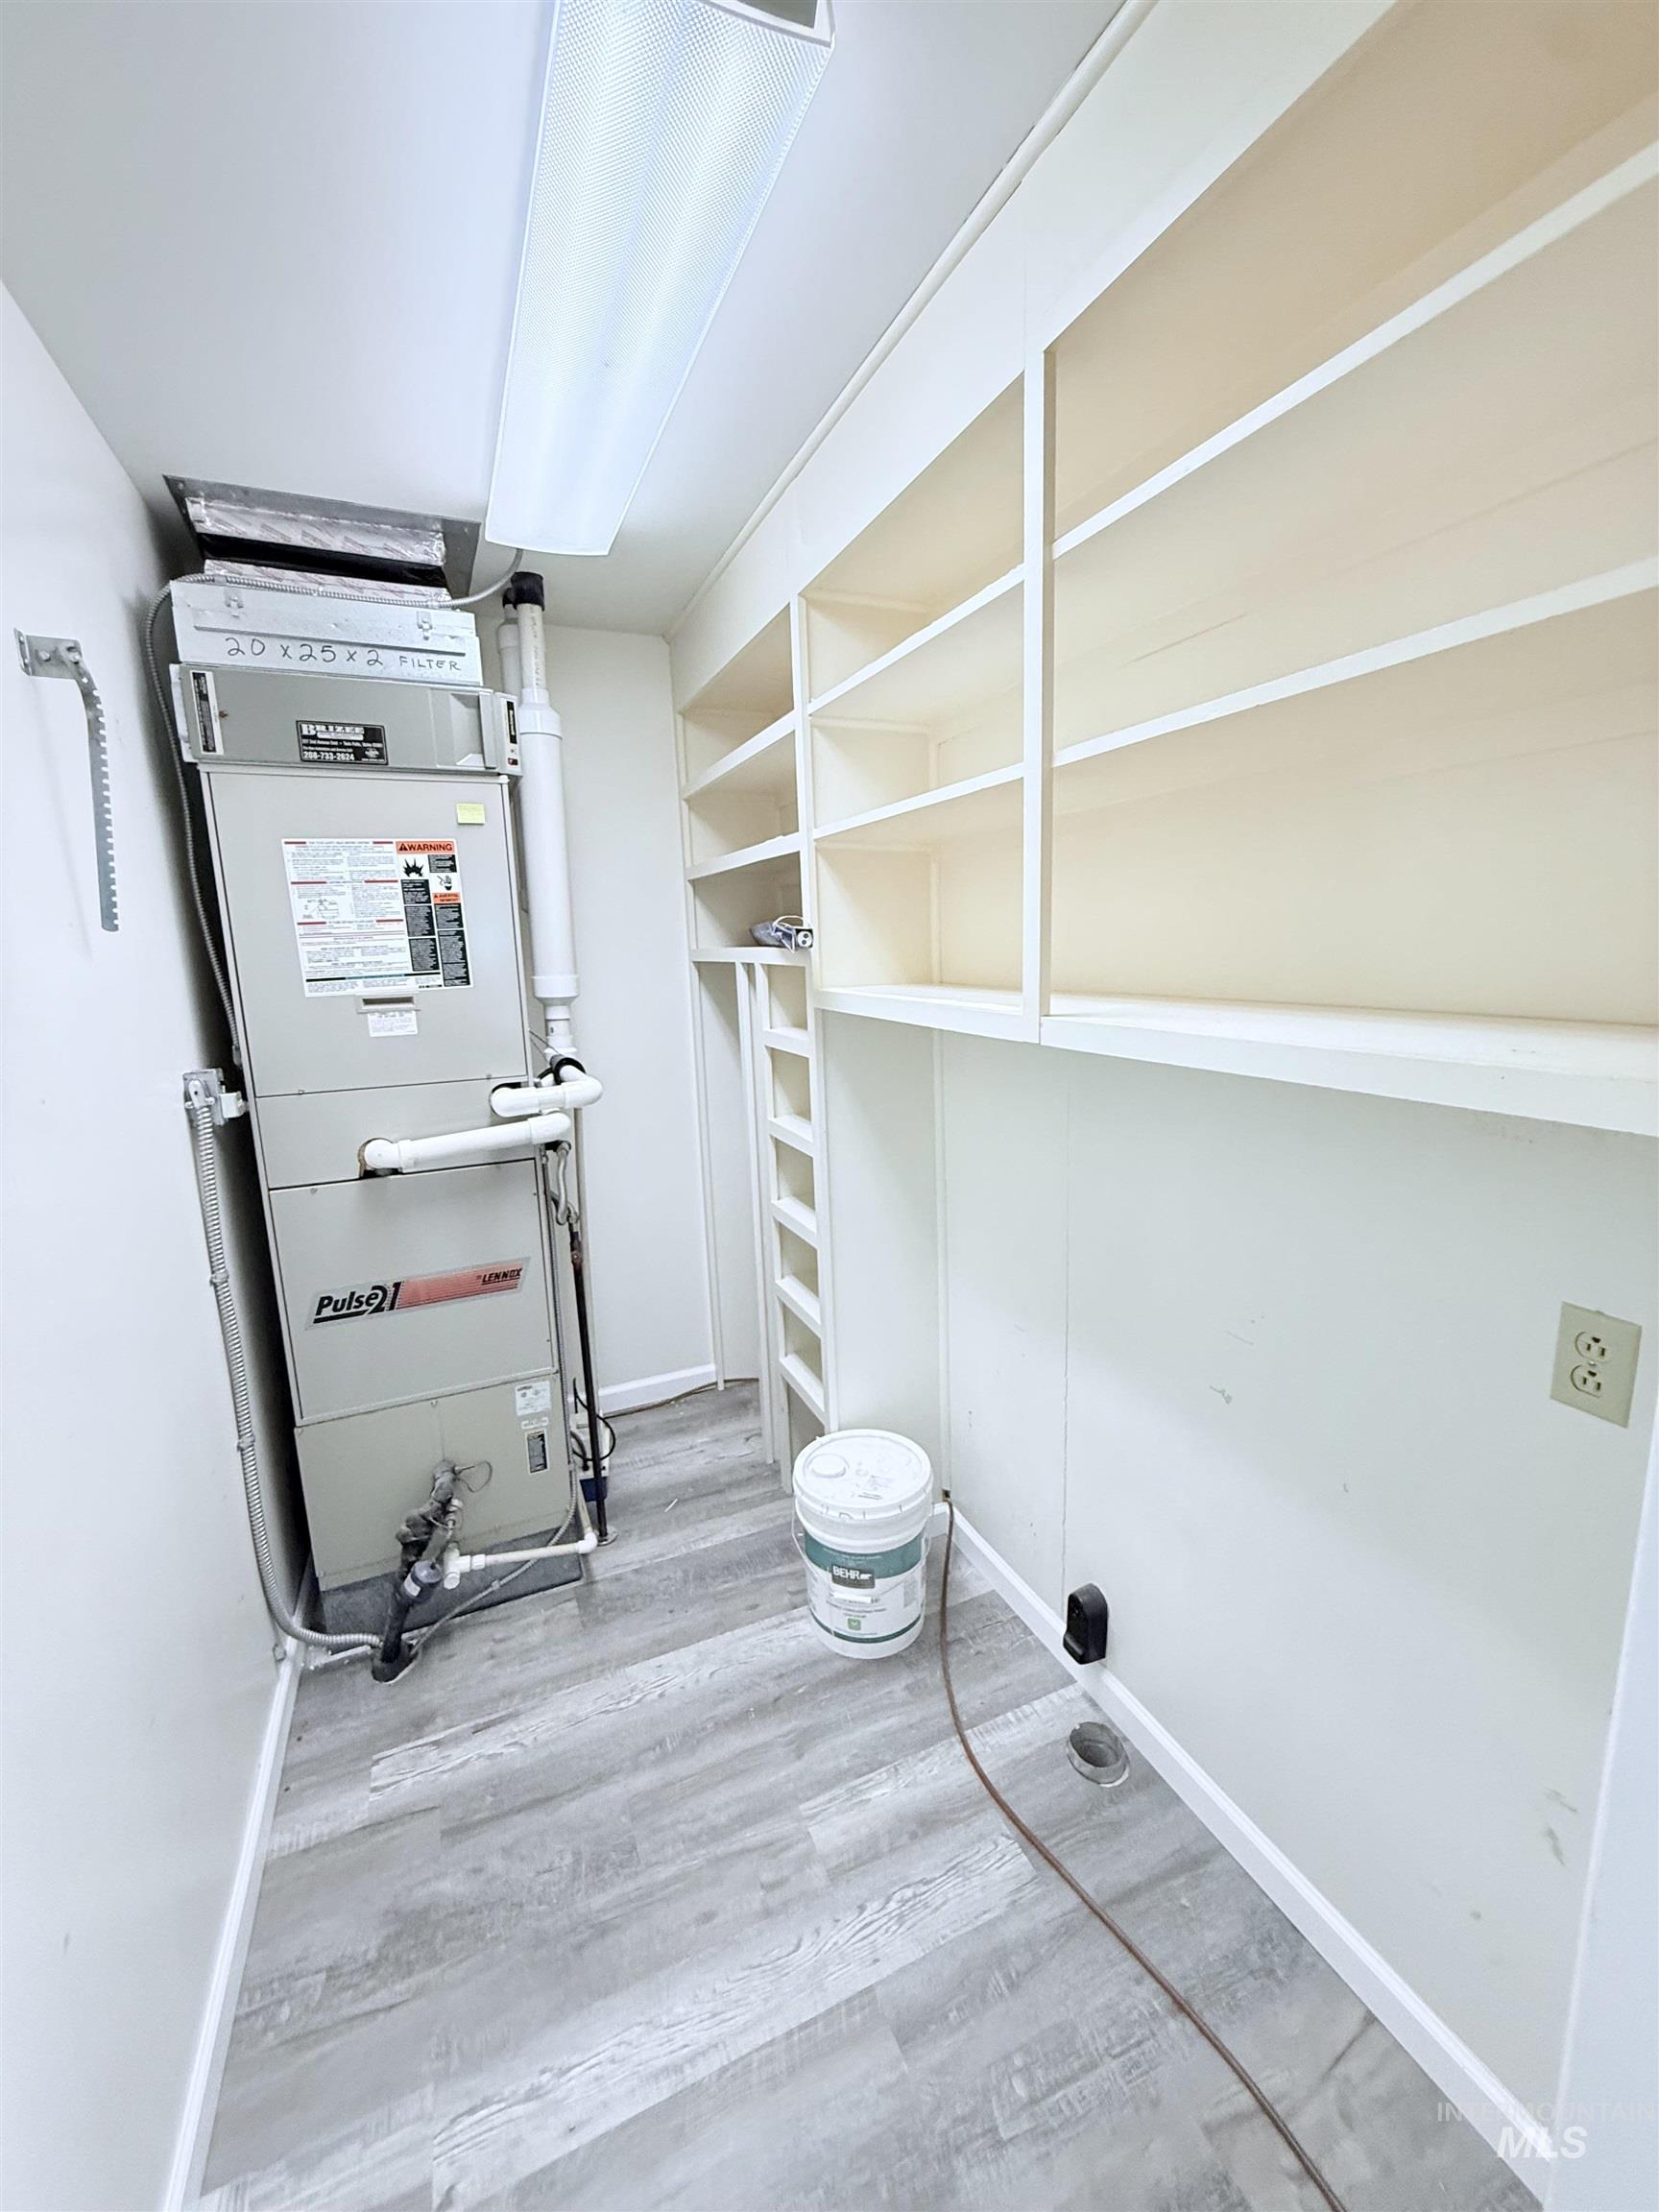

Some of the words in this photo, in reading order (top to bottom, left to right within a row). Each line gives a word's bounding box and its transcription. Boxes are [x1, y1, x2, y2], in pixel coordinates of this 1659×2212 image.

[225, 637, 267, 657] 20
[299, 642, 337, 663] 25
[367, 648, 384, 666] 2
[398, 656, 462, 671] FILTER
[407, 843, 453, 852] WARNING
[482, 1267, 522, 1283] LENNOX
[832, 1565, 860, 1580] BEHR
